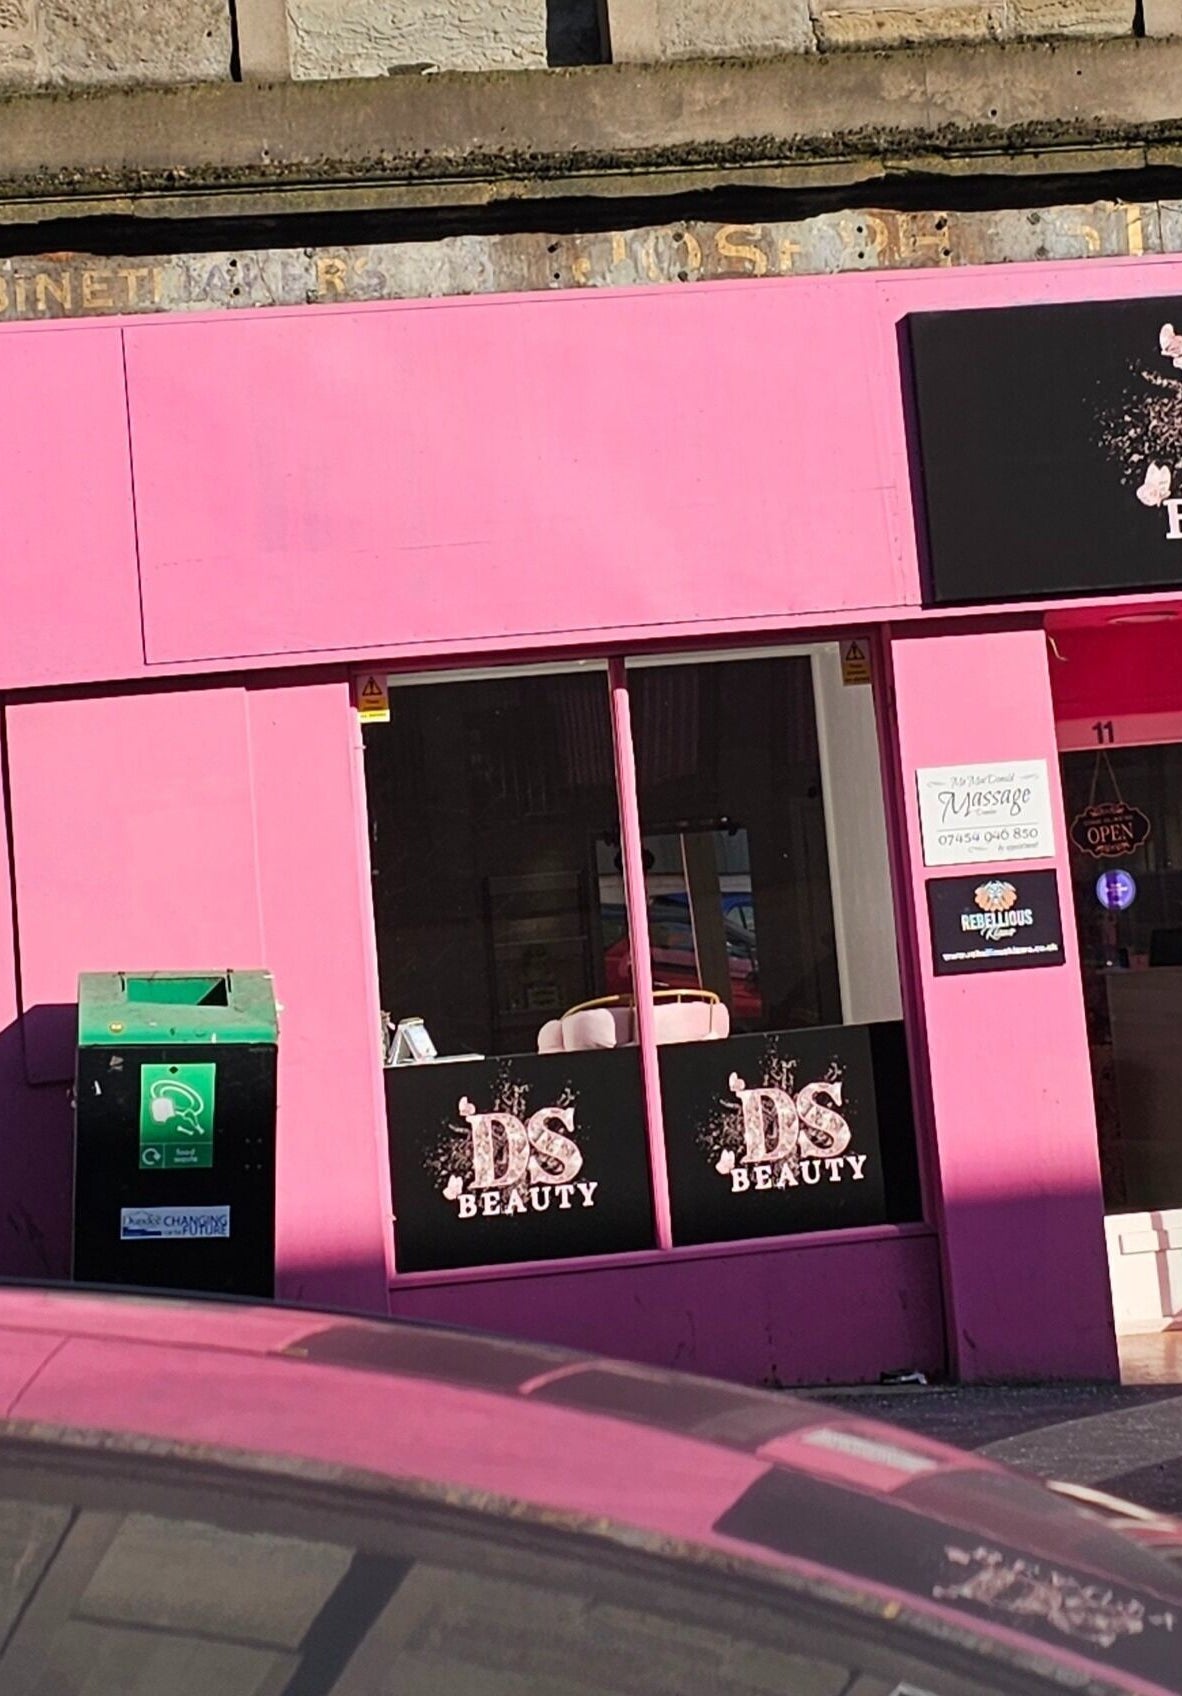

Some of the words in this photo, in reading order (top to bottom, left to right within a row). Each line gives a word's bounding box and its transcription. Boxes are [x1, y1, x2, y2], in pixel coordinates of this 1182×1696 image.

[1092, 721, 1114, 744] 11
[938, 788, 1031, 823] Massage
[1087, 822, 1135, 845] OPEN
[961, 909, 1033, 931] REBELLIOUS
[736, 1081, 852, 1163] DS
[466, 1107, 584, 1190] DS
[730, 1155, 868, 1193] BEAUTY
[457, 1182, 599, 1219] BEAUTY
[163, 1214, 228, 1227] CHANGING
